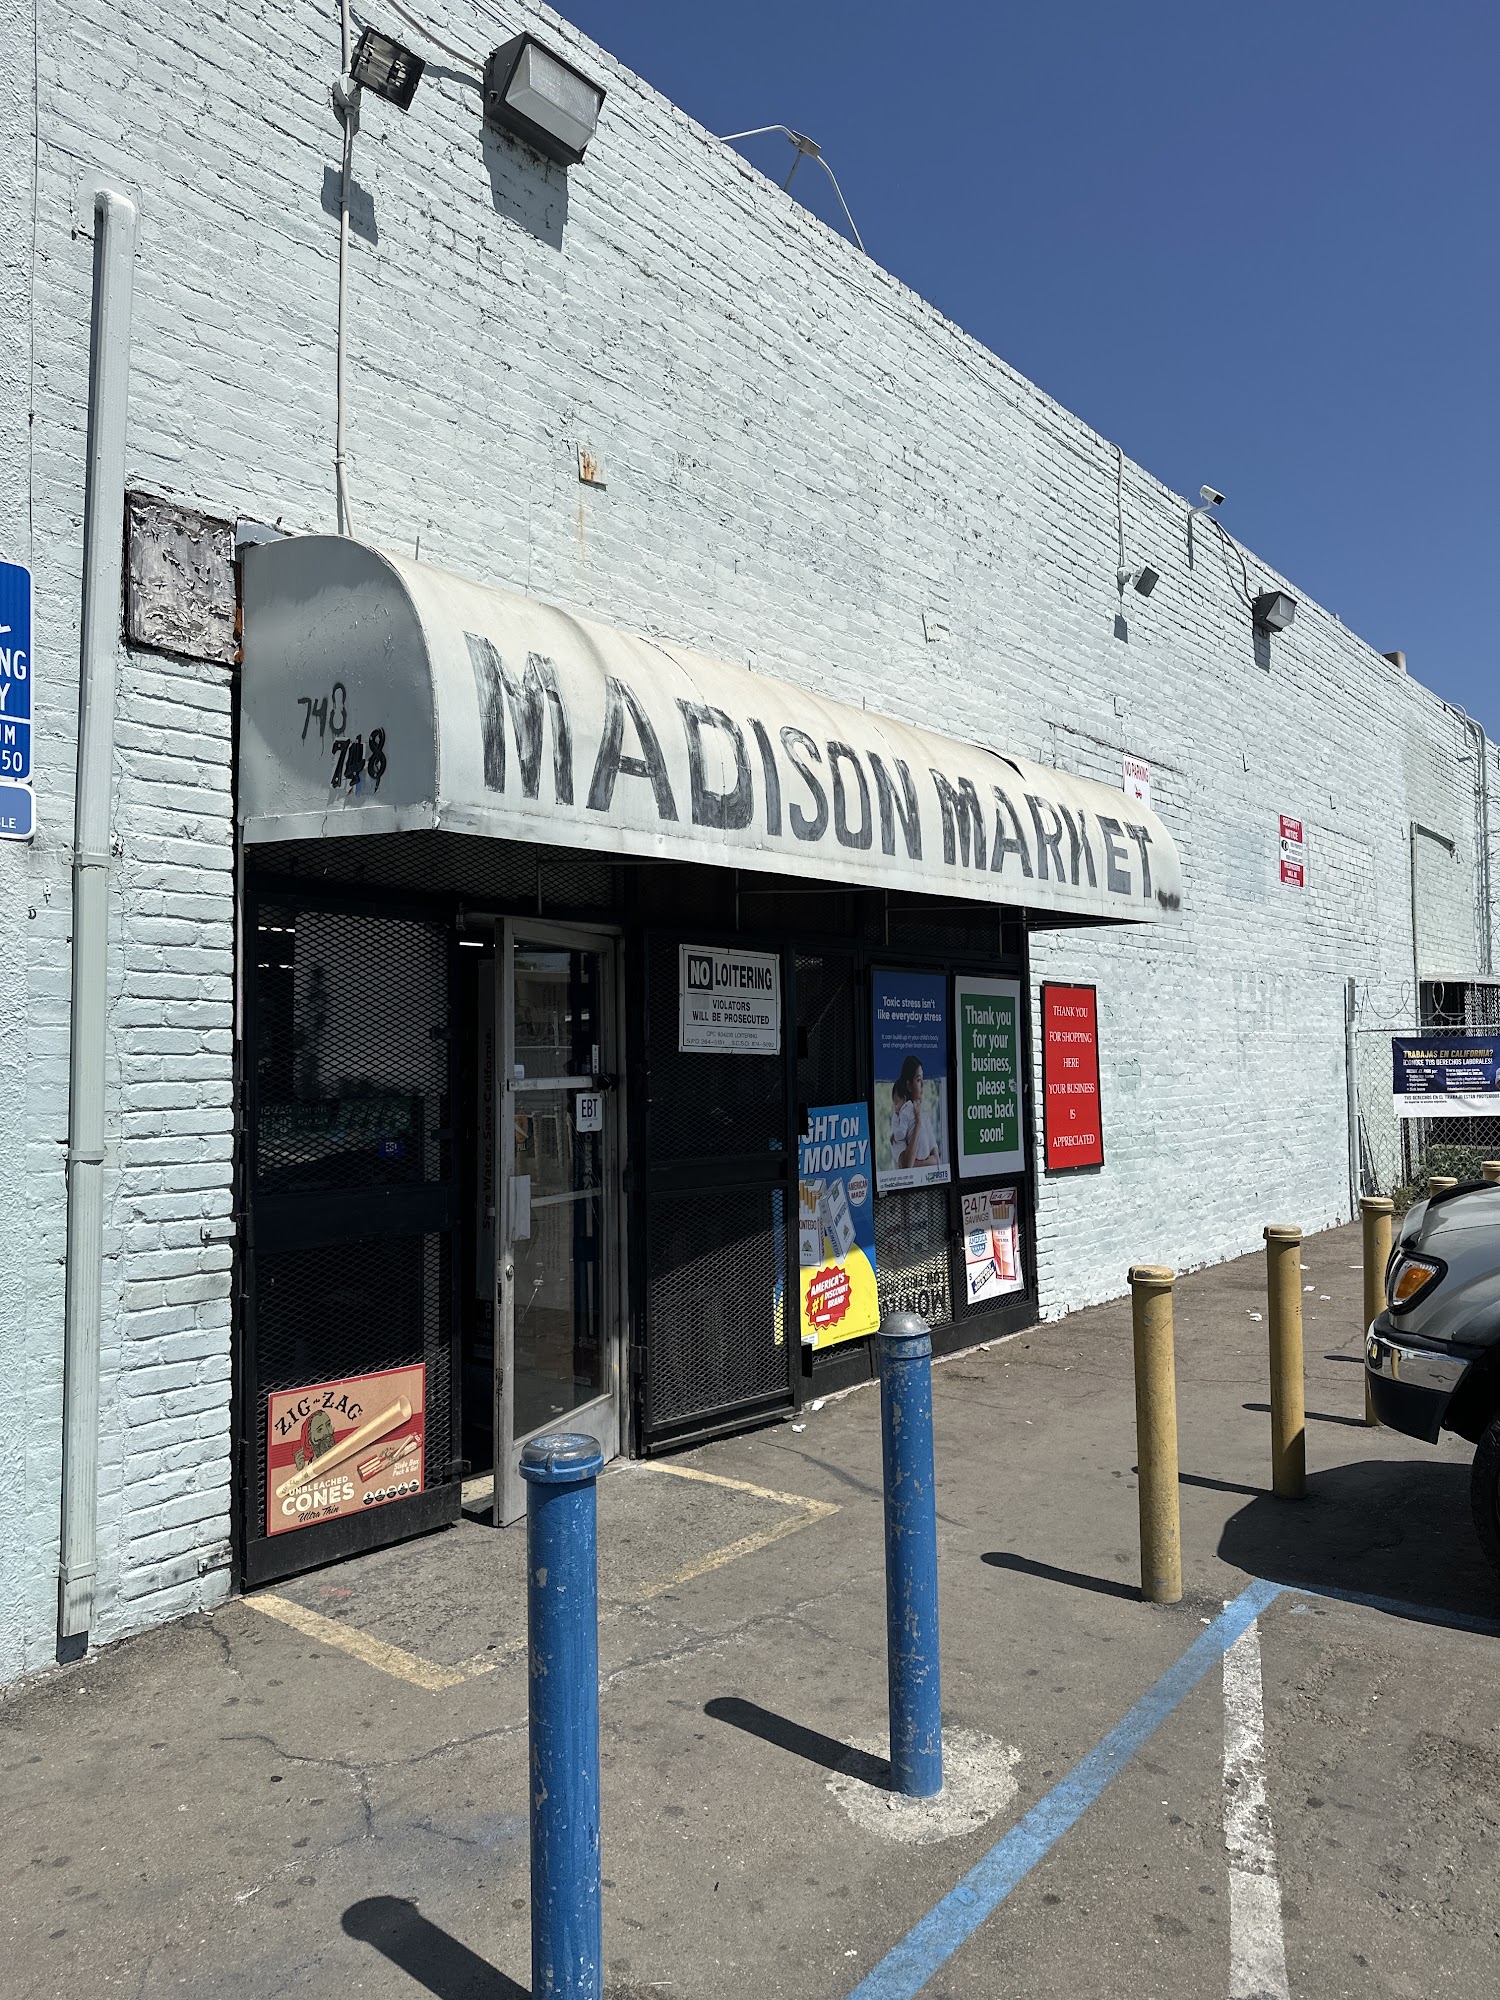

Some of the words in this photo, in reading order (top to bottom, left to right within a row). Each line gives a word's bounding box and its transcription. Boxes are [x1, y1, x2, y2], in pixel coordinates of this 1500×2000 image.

[297, 682, 347, 740] 748
[0, 723, 16, 746] M
[2, 750, 23, 772] 50
[463, 629, 923, 862] MADISON
[929, 767, 1153, 899] MARKET
[1132, 762, 1149, 783] PARKING
[1282, 816, 1300, 831] SECURITY
[1284, 827, 1299, 841] NOTICE
[690, 960, 710, 986] NO
[715, 962, 773, 991] LOITERING
[712, 999, 751, 1012] VIOLATORS
[883, 996, 900, 1007] Toxic
[902, 998, 921, 1008] stress
[921, 998, 935, 1009] isn't
[1053, 1005, 1075, 1017] THANK
[1075, 1007, 1089, 1018] YOU
[692, 1010, 709, 1021] WILL
[712, 1012, 721, 1022] BE
[724, 1013, 770, 1025] PROSECUTED
[877, 1009, 890, 1020] like
[891, 1011, 921, 1023] everyday
[923, 1012, 942, 1022] stress
[965, 1005, 995, 1026] Thank
[995, 1011, 1012, 1031] you
[972, 1029, 987, 1049] for
[989, 1033, 1009, 1054] your
[1049, 1031, 1062, 1042] FOR
[1062, 1032, 1093, 1043] SHOPPING
[971, 1052, 1012, 1074] business,
[1063, 1057, 1080, 1068] HERE
[1403, 1050, 1438, 1059] TRABAJAS
[1440, 1050, 1450, 1058] EN
[1450, 1049, 1494, 1058] CALIFORNIA?
[1436, 1058, 1462, 1066] DERECHOS
[1463, 1057, 1493, 1065] LABORALES!
[483, 1028, 492, 1103] California.
[976, 1076, 1006, 1100] please
[1048, 1083, 1067, 1095] YOUR
[1067, 1082, 1095, 1094] BUSINESS
[581, 1098, 598, 1118] EBT
[967, 1105, 992, 1120] come
[994, 1099, 1015, 1119] back
[1069, 1109, 1076, 1120] IS
[483, 1106, 492, 1140] Save
[798, 1114, 839, 1145] GHT
[841, 1116, 860, 1139] ON
[979, 1122, 1004, 1143] soon!
[1052, 1133, 1096, 1148] APPRECIATED
[803, 1139, 869, 1175] MONEY
[483, 1144, 492, 1191] Water.
[848, 1179, 868, 1191] AMERICAN
[851, 1190, 866, 1199] MADE
[963, 1195, 988, 1216] 24/7
[992, 1192, 1013, 1200] 24/7
[799, 1219, 817, 1231] ONTEGO
[964, 1212, 990, 1226] SAVINGS
[810, 1272, 845, 1297] AMERICA'S
[811, 1293, 825, 1316] #1
[824, 1283, 849, 1300] DISCOUNT
[827, 1295, 845, 1309] BRAND
[274, 1391, 364, 1436] ZIG-ZAG
[392, 1469, 405, 1477] Pack
[394, 1461, 408, 1470] Slide
[409, 1459, 419, 1467] Box
[289, 1475, 349, 1497] UNBLEACHED
[281, 1482, 355, 1516] CONES
[298, 1510, 321, 1522] Ultra
[322, 1505, 339, 1517] Thin
